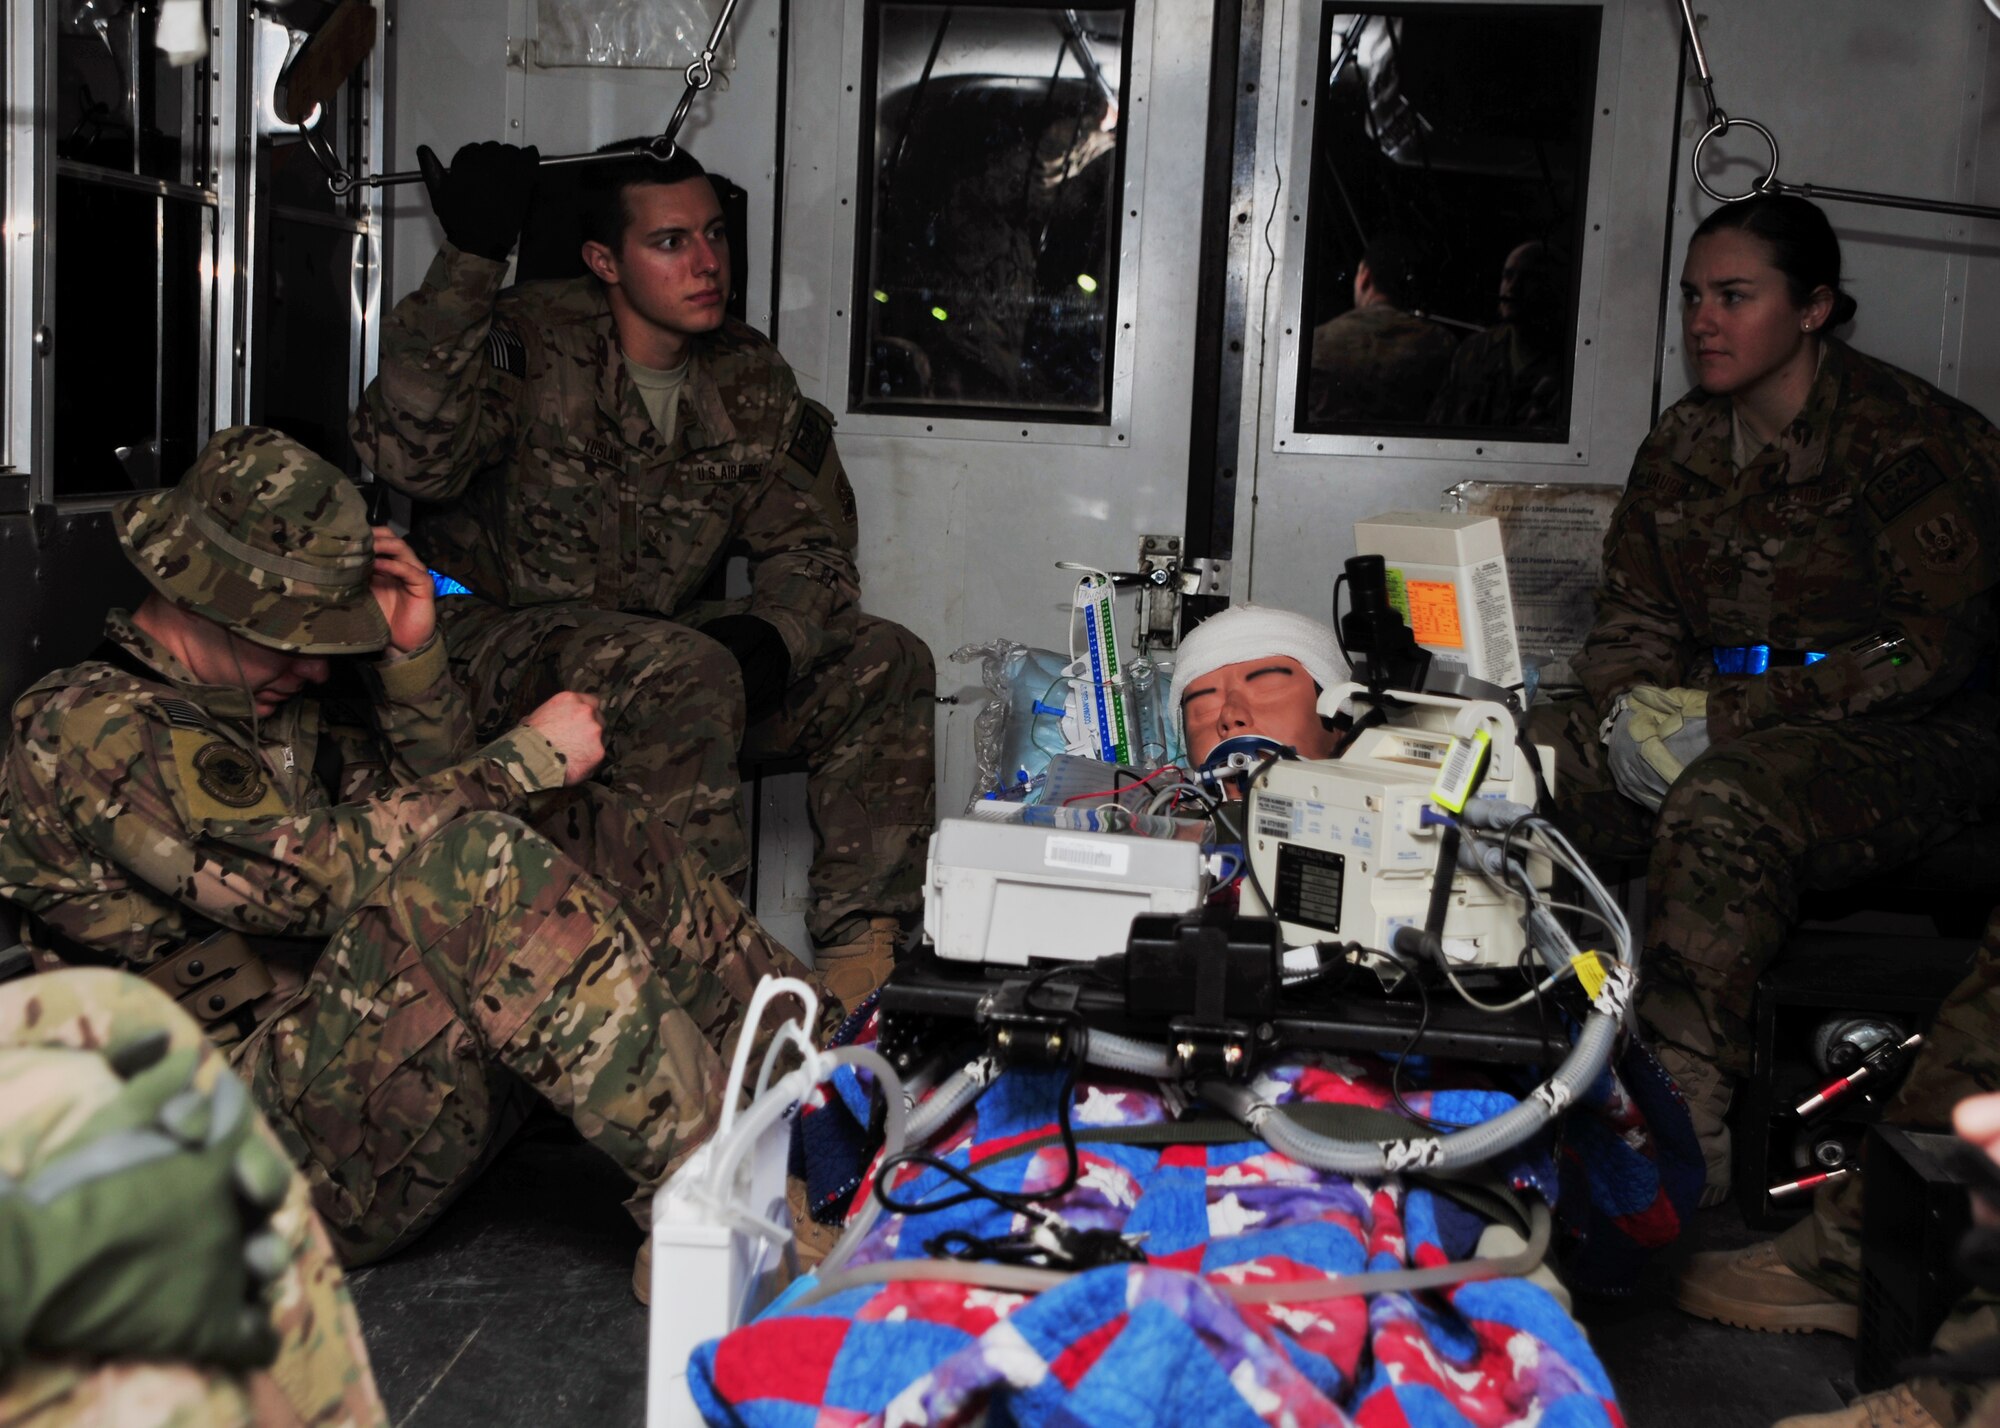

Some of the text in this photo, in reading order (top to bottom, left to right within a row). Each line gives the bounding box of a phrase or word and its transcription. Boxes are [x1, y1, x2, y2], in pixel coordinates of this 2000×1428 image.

[720, 464, 737, 481] AIR
[1876, 457, 1917, 496] ISAF
[1495, 504, 1510, 513] C-17
[1544, 506, 1567, 515] Patient
[1569, 507, 1594, 516] Loading
[1530, 557, 1552, 565] Patient
[1553, 558, 1578, 567] Loading
